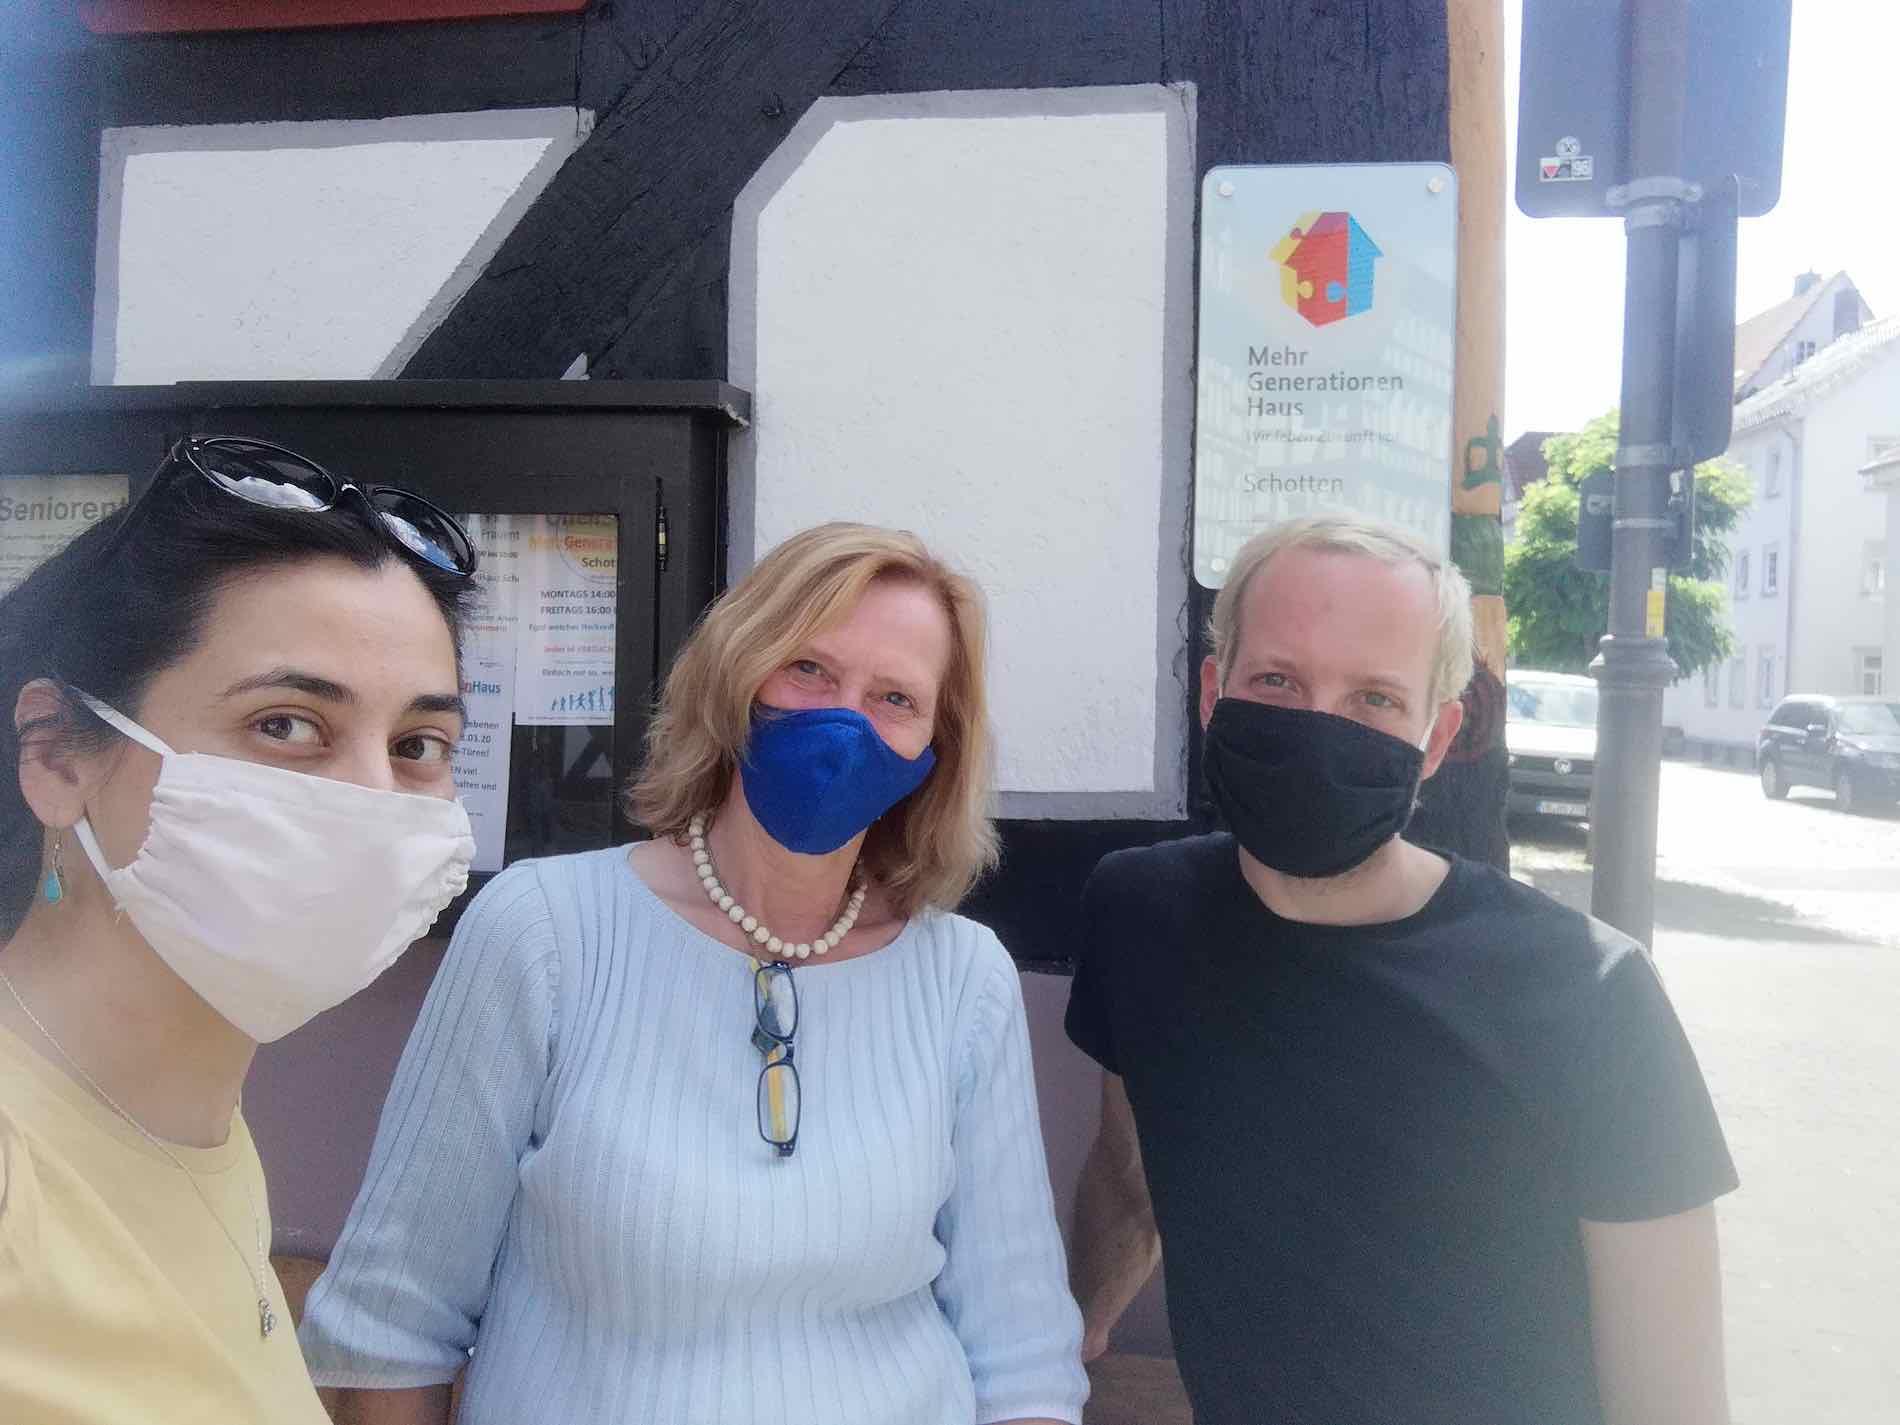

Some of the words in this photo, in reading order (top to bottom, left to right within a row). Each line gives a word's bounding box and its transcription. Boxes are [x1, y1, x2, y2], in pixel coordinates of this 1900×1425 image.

[1248, 345, 1308, 367] Mehr
[1247, 371, 1404, 392] Generationen
[1247, 396, 1304, 416] Haus
[1243, 471, 1343, 493] Schotten
[0, 497, 128, 522] Senioren
[582, 557, 616, 569] Schot
[541, 590, 588, 600] MONTAGS
[590, 590, 615, 600] 14:00
[541, 606, 583, 616] FREITAGS
[586, 606, 611, 616] 16:00
[463, 681, 501, 694] nHaus
[462, 734, 491, 744] .03.20
